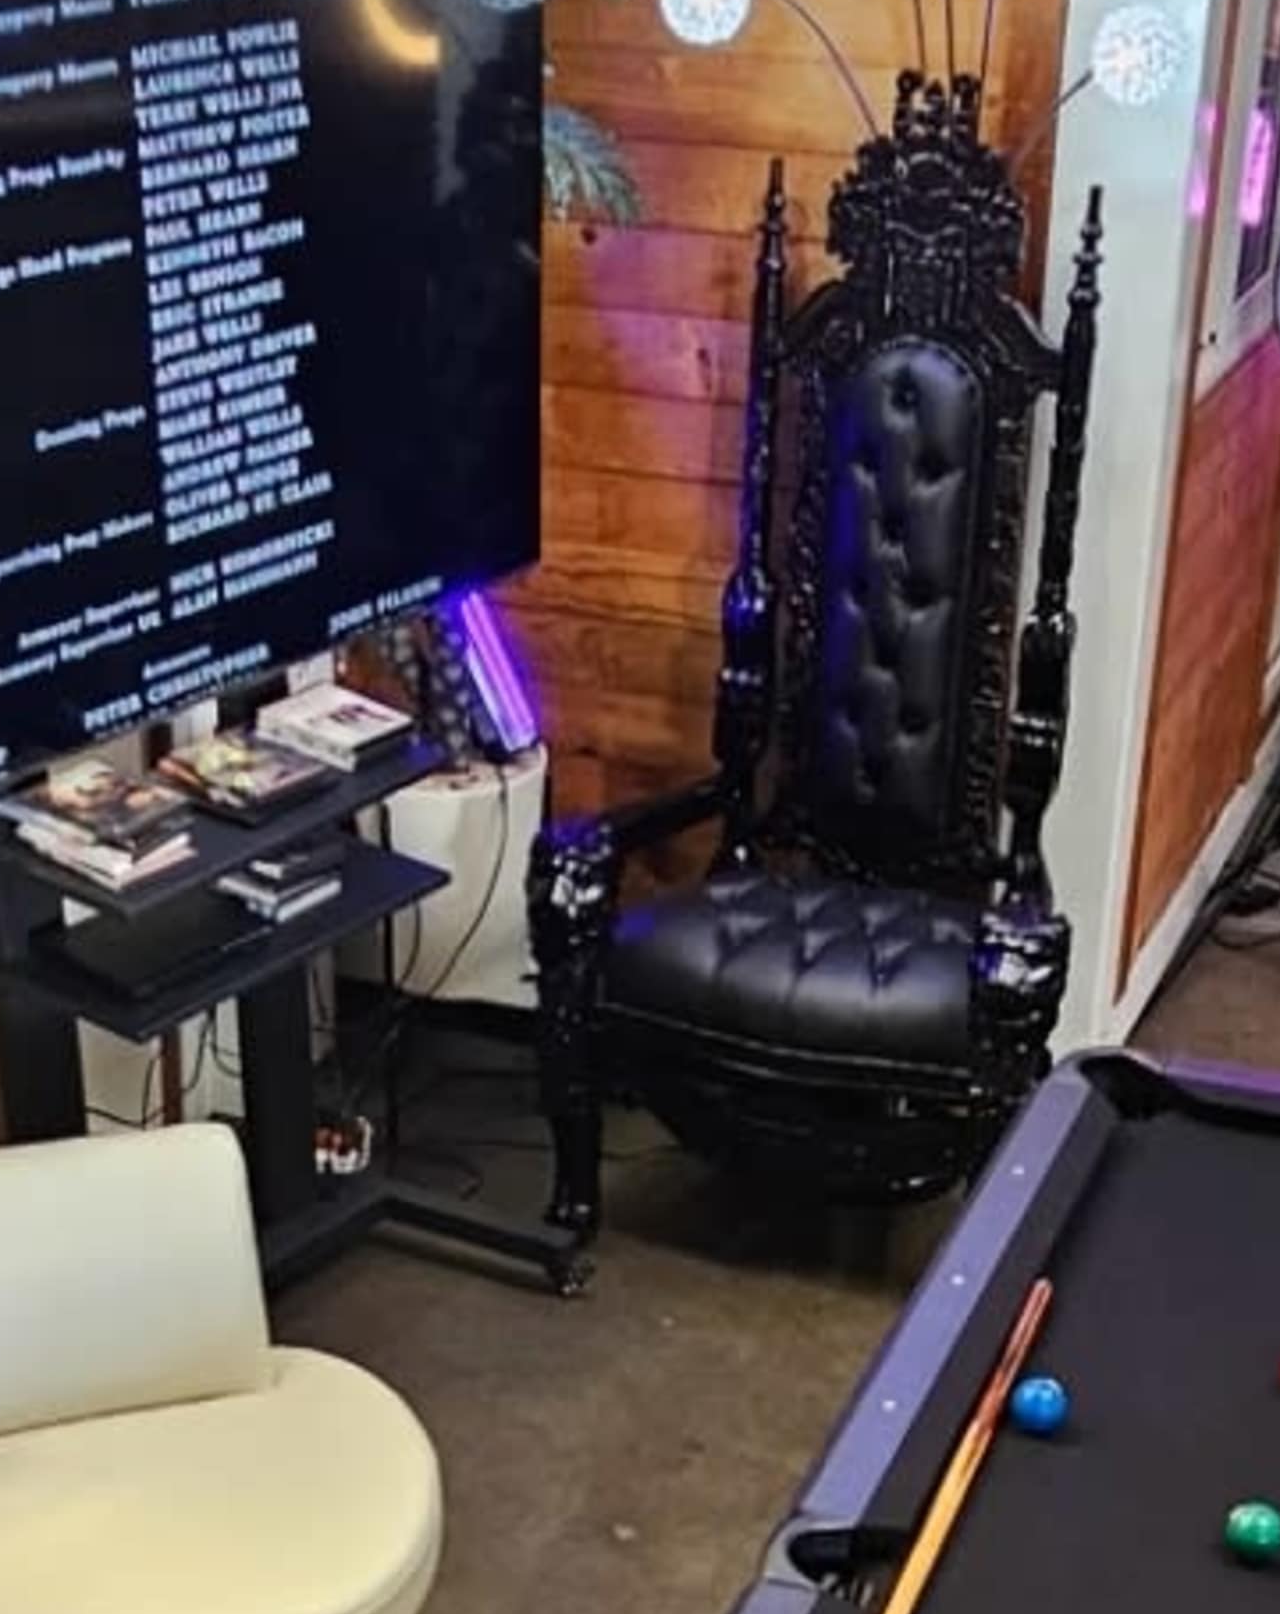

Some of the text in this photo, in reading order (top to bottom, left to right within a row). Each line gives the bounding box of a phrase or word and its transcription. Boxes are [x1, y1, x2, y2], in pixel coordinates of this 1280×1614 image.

[130, 34, 221, 69] MICHAEL
[239, 48, 299, 78] WELLS
[134, 98, 196, 130] TERRY
[201, 84, 264, 115] WELLS
[137, 104, 309, 160] MATTHEW FOSTER
[140, 136, 297, 190] BERNARD HEARN
[141, 170, 267, 218] PETER WELLS
[144, 202, 261, 248] PAUL HEARN
[146, 219, 303, 275] KENNETH BACON
[17, 249, 64, 278] Hand
[187, 257, 261, 293] BENSON
[150, 278, 283, 332] ERIC STRANGE
[201, 311, 261, 344] WELLS
[154, 323, 315, 386] ANTHONY DRIVER
[156, 379, 213, 413] STEVE
[159, 404, 302, 465] WILLIAM WELLS
[163, 450, 240, 492] ANDREW
[164, 479, 231, 517] OLIVER
[166, 500, 249, 543] RICHARD
[279, 472, 331, 503] CLAIR
[136, 610, 161, 632] UK
[171, 586, 218, 618] ALAN
[83, 693, 142, 729] PETER
[146, 643, 269, 704] CHRISTOPHER
